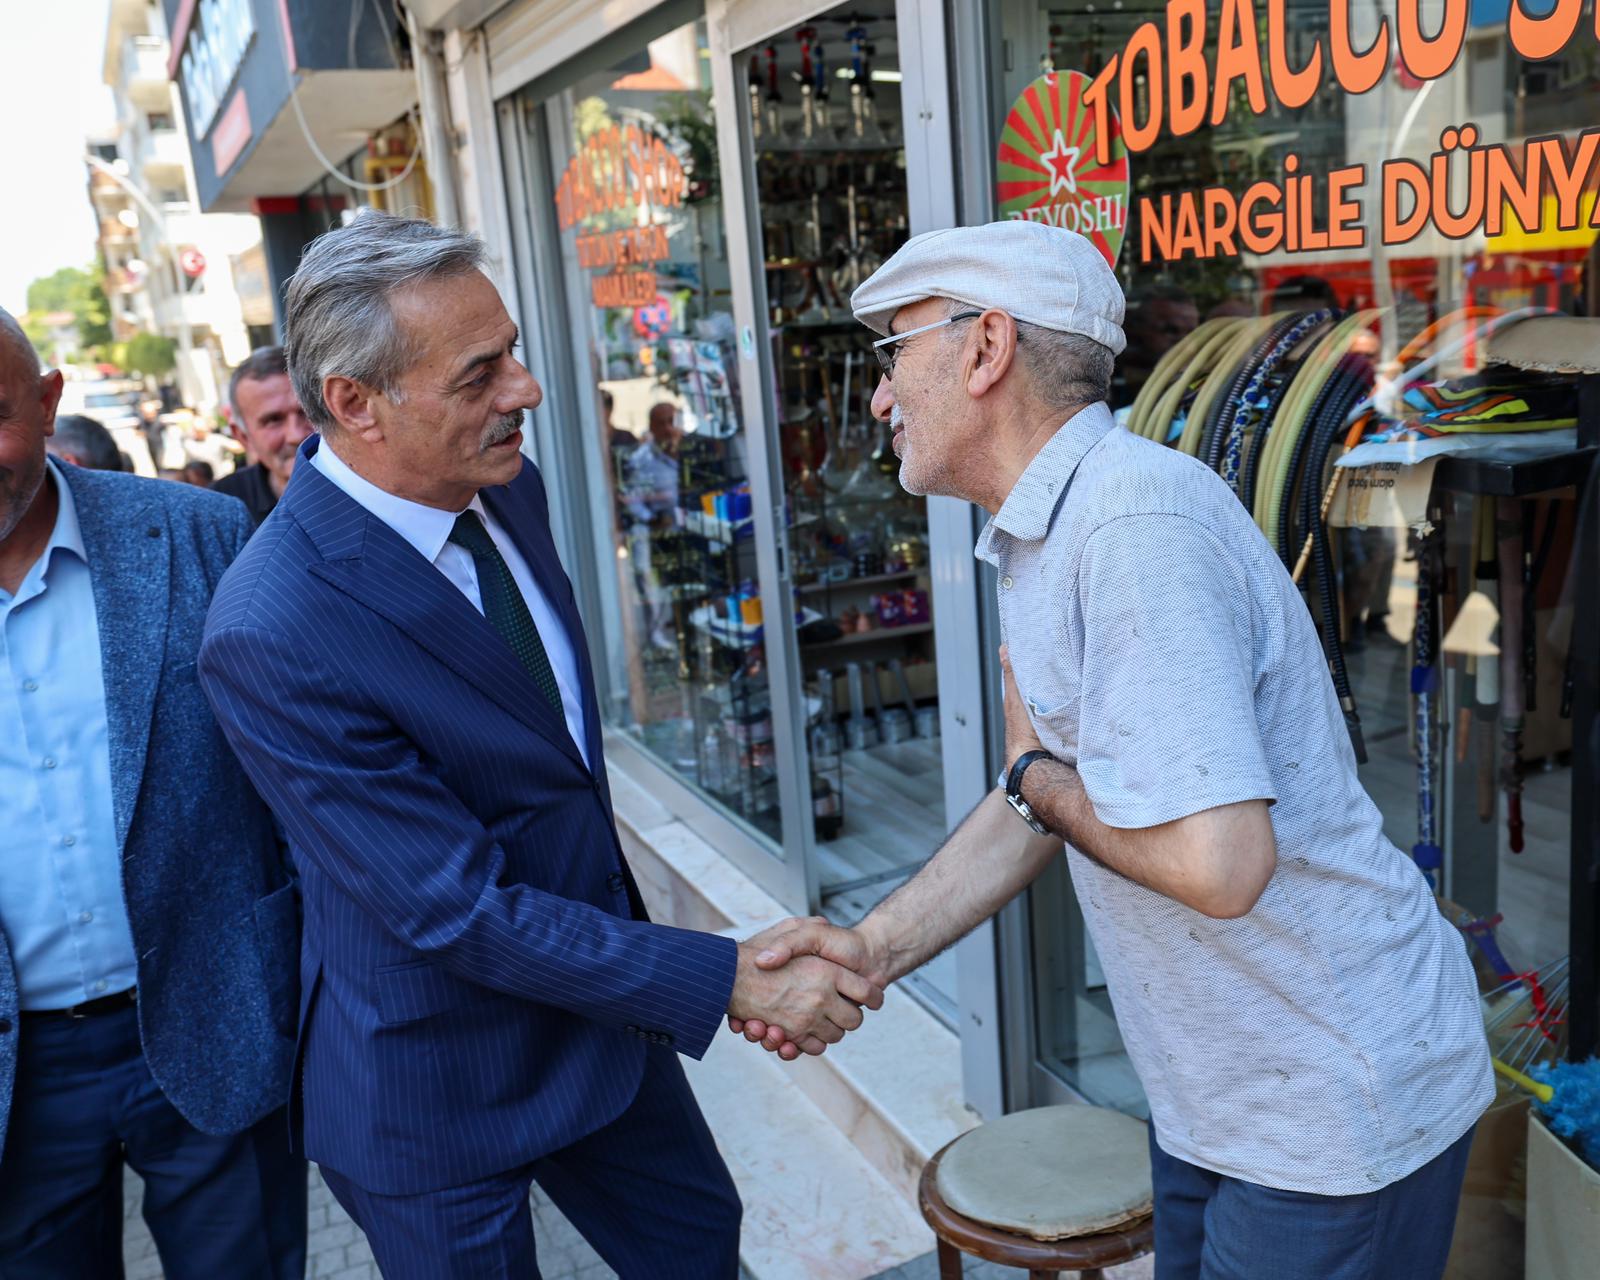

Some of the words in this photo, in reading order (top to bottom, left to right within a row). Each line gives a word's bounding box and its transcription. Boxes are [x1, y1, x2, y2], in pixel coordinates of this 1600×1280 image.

[1082, 0, 1469, 166] TOBACCO
[1139, 152, 1365, 263] NARGİLE
[1382, 122, 1600, 246] DÜNY
